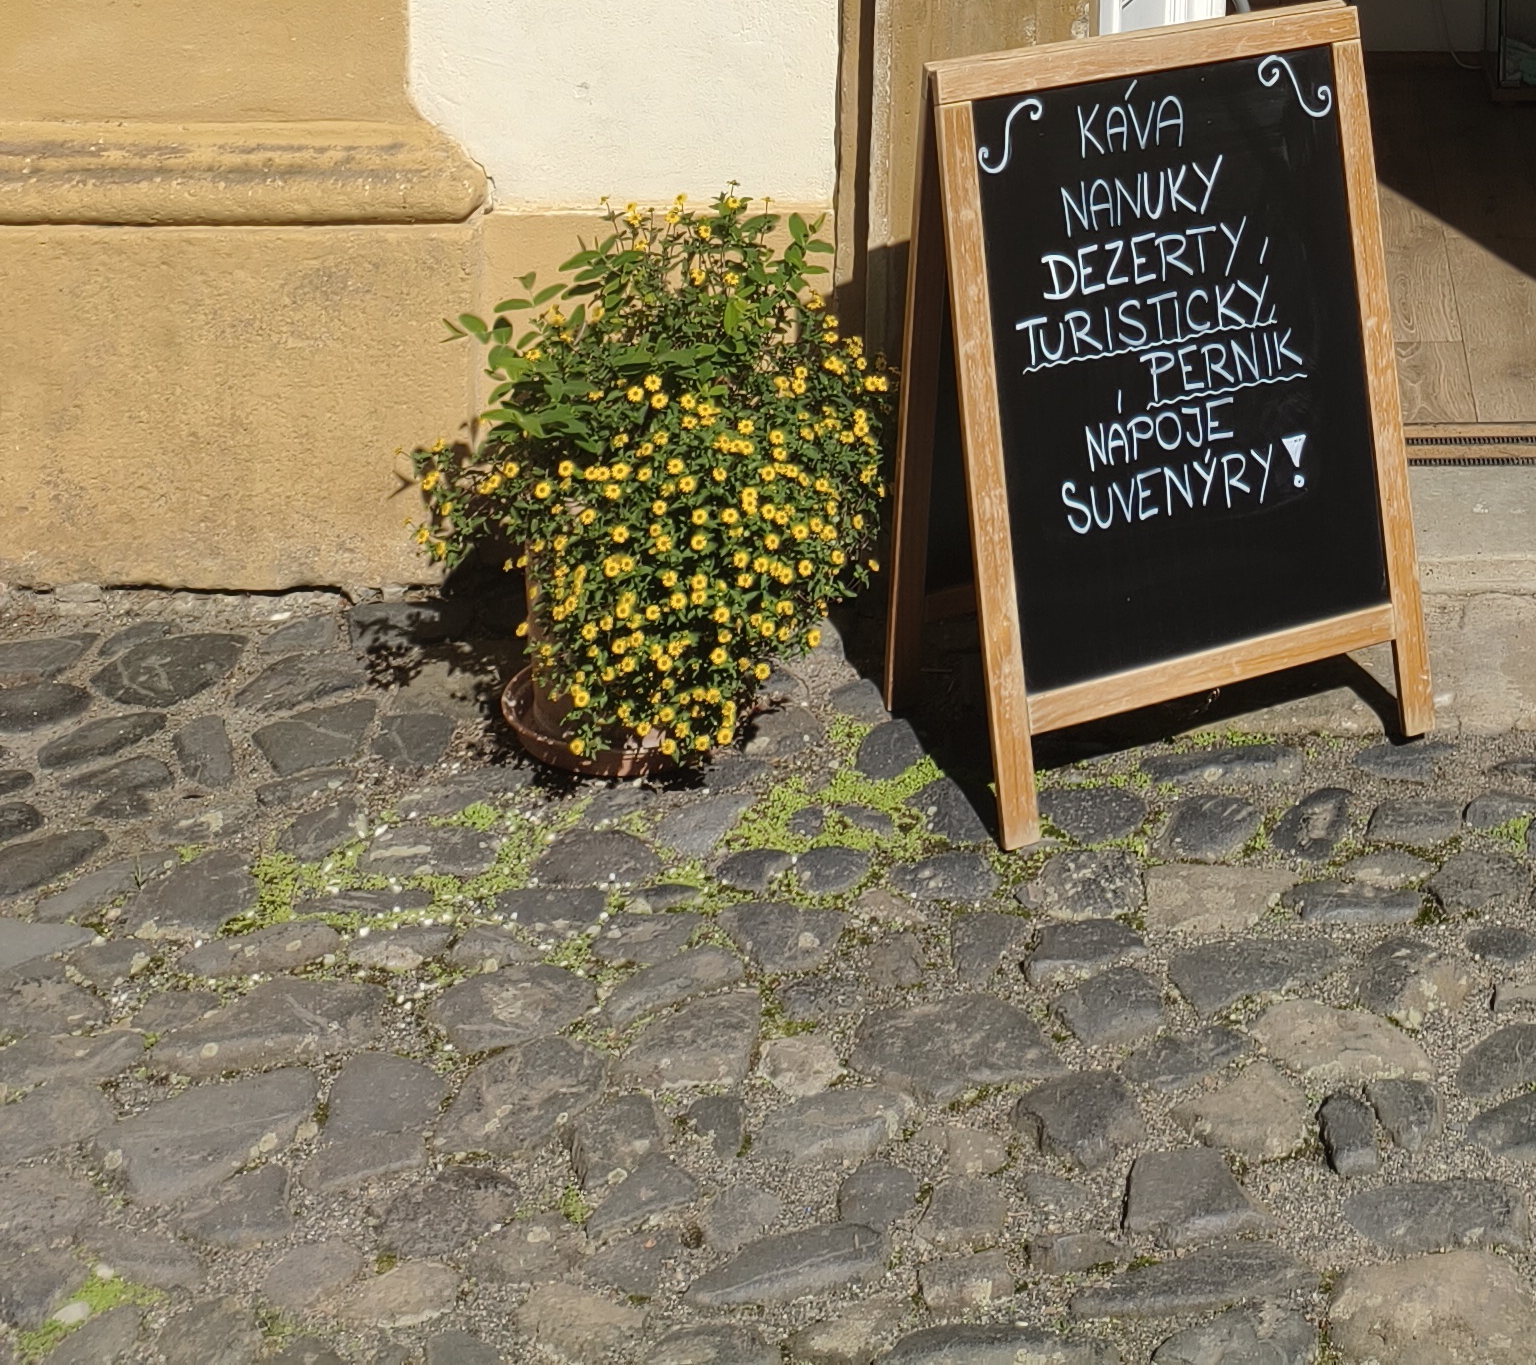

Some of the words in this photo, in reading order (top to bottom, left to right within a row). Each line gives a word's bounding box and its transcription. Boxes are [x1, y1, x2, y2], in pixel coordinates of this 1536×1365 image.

[1077, 78, 1185, 158] KÁVA
[1059, 154, 1224, 237] NANUKY
[1085, 388, 1235, 472] NÁPOJE
